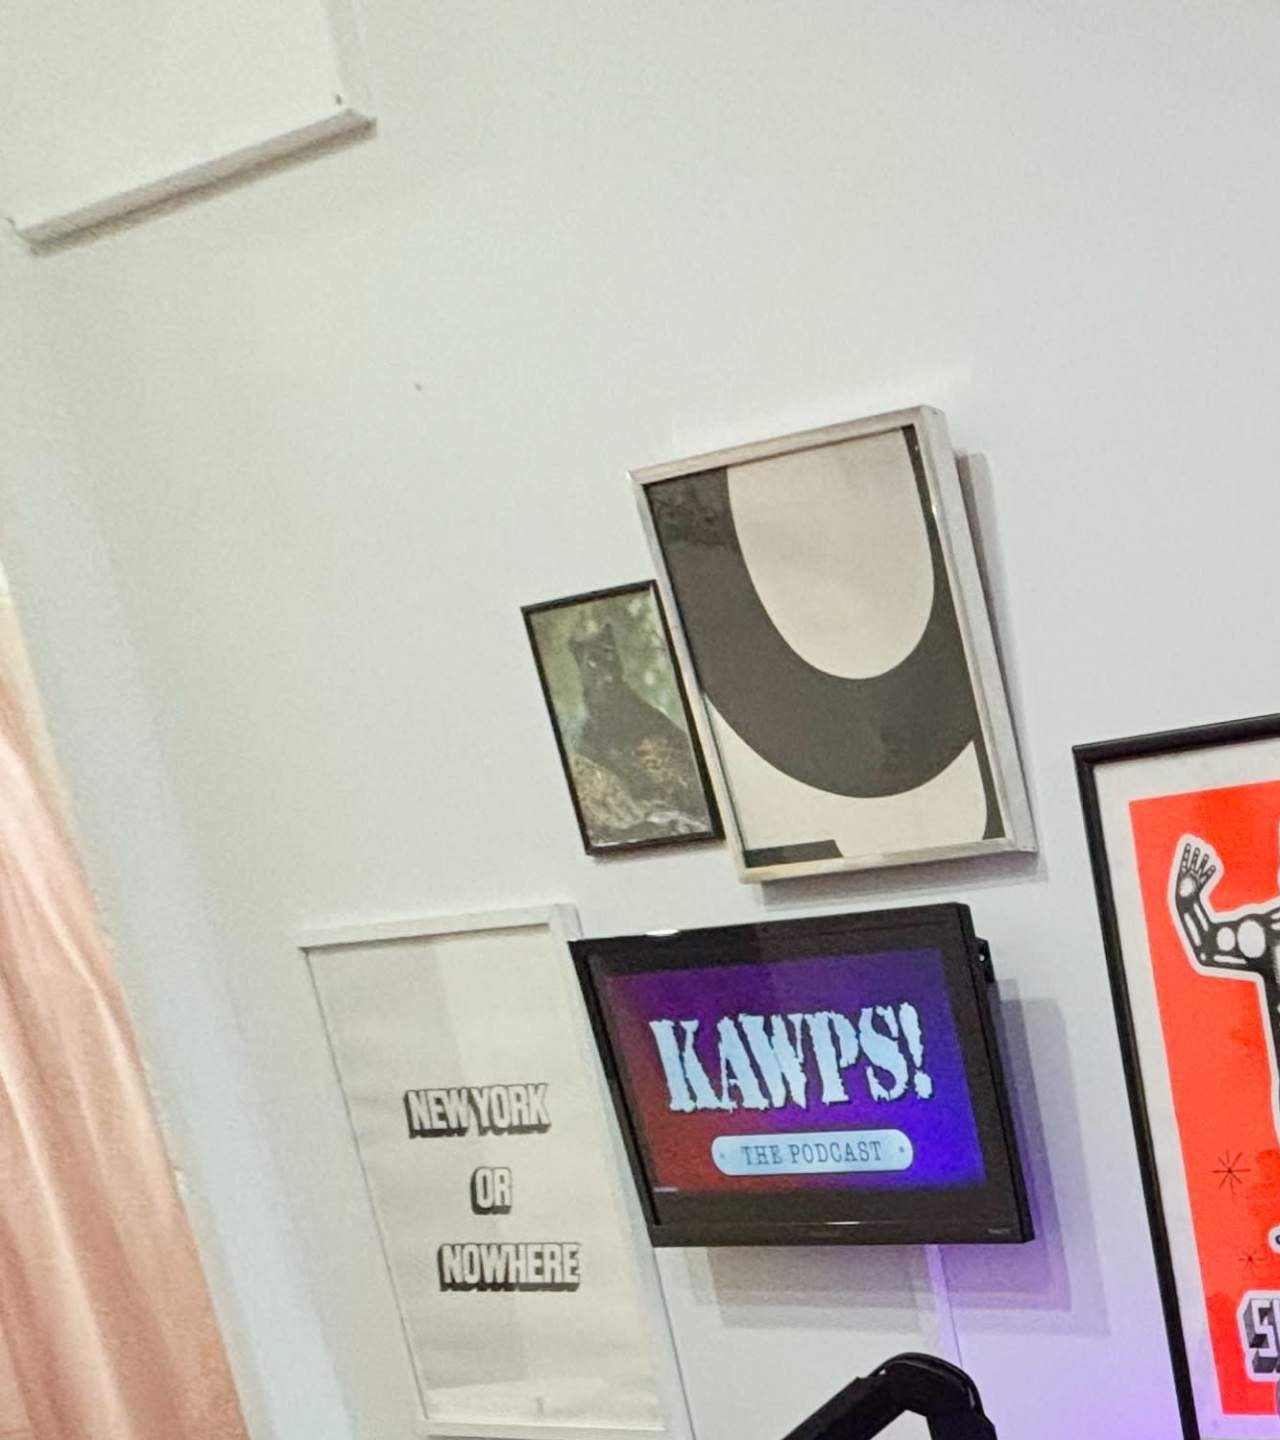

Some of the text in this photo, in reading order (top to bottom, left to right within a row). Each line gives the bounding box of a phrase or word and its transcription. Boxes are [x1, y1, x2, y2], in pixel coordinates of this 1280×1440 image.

[648, 1002, 934, 1113] KAWPS!
[403, 1083, 552, 1139] NEW YORK
[740, 1140, 883, 1167] THE PODCAST
[470, 1166, 512, 1216] OR
[437, 1242, 582, 1292] NOWHERE
